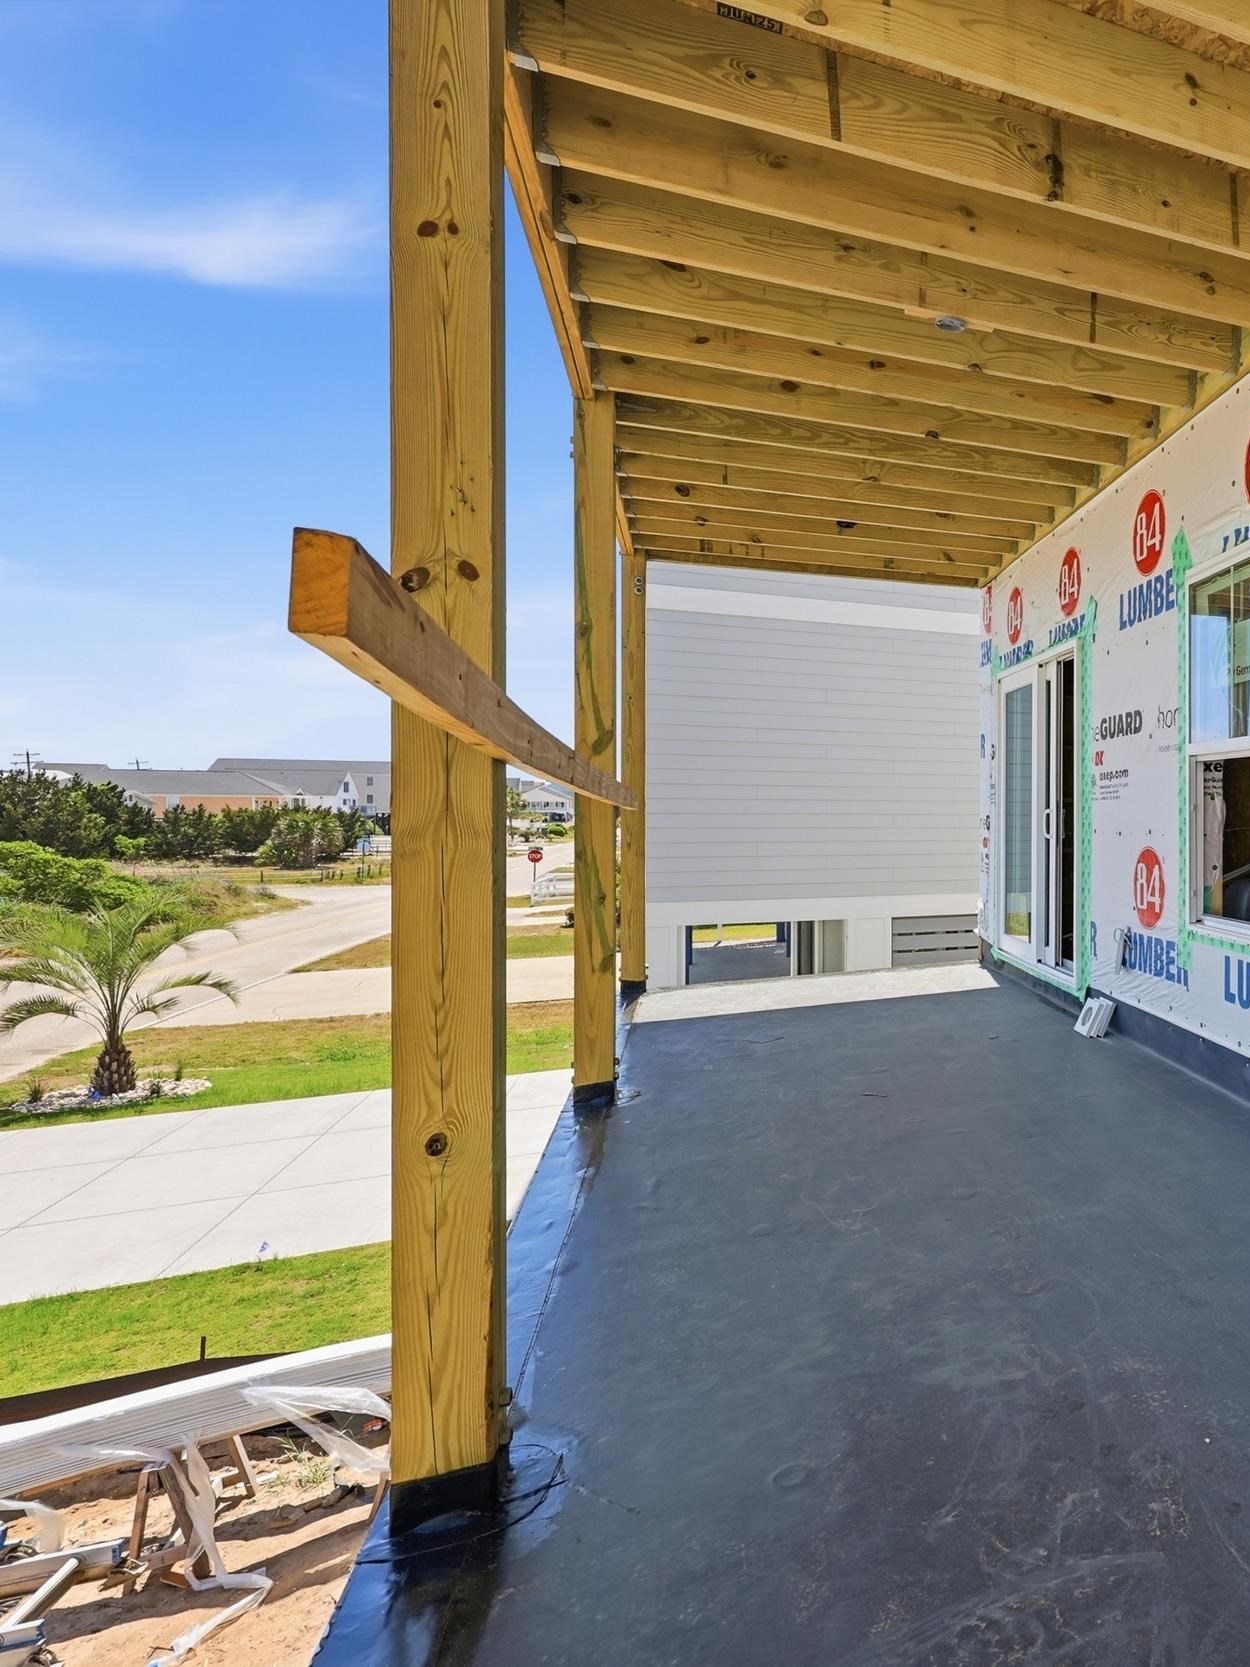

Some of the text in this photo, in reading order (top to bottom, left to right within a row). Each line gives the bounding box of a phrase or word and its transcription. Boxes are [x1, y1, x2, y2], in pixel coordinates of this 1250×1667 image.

[1136, 502, 1161, 562] 84
[1061, 559, 1078, 605] 84
[1119, 567, 1178, 631] LUMBE
[1008, 595, 1021, 635] 84
[1137, 862, 1160, 913] 84
